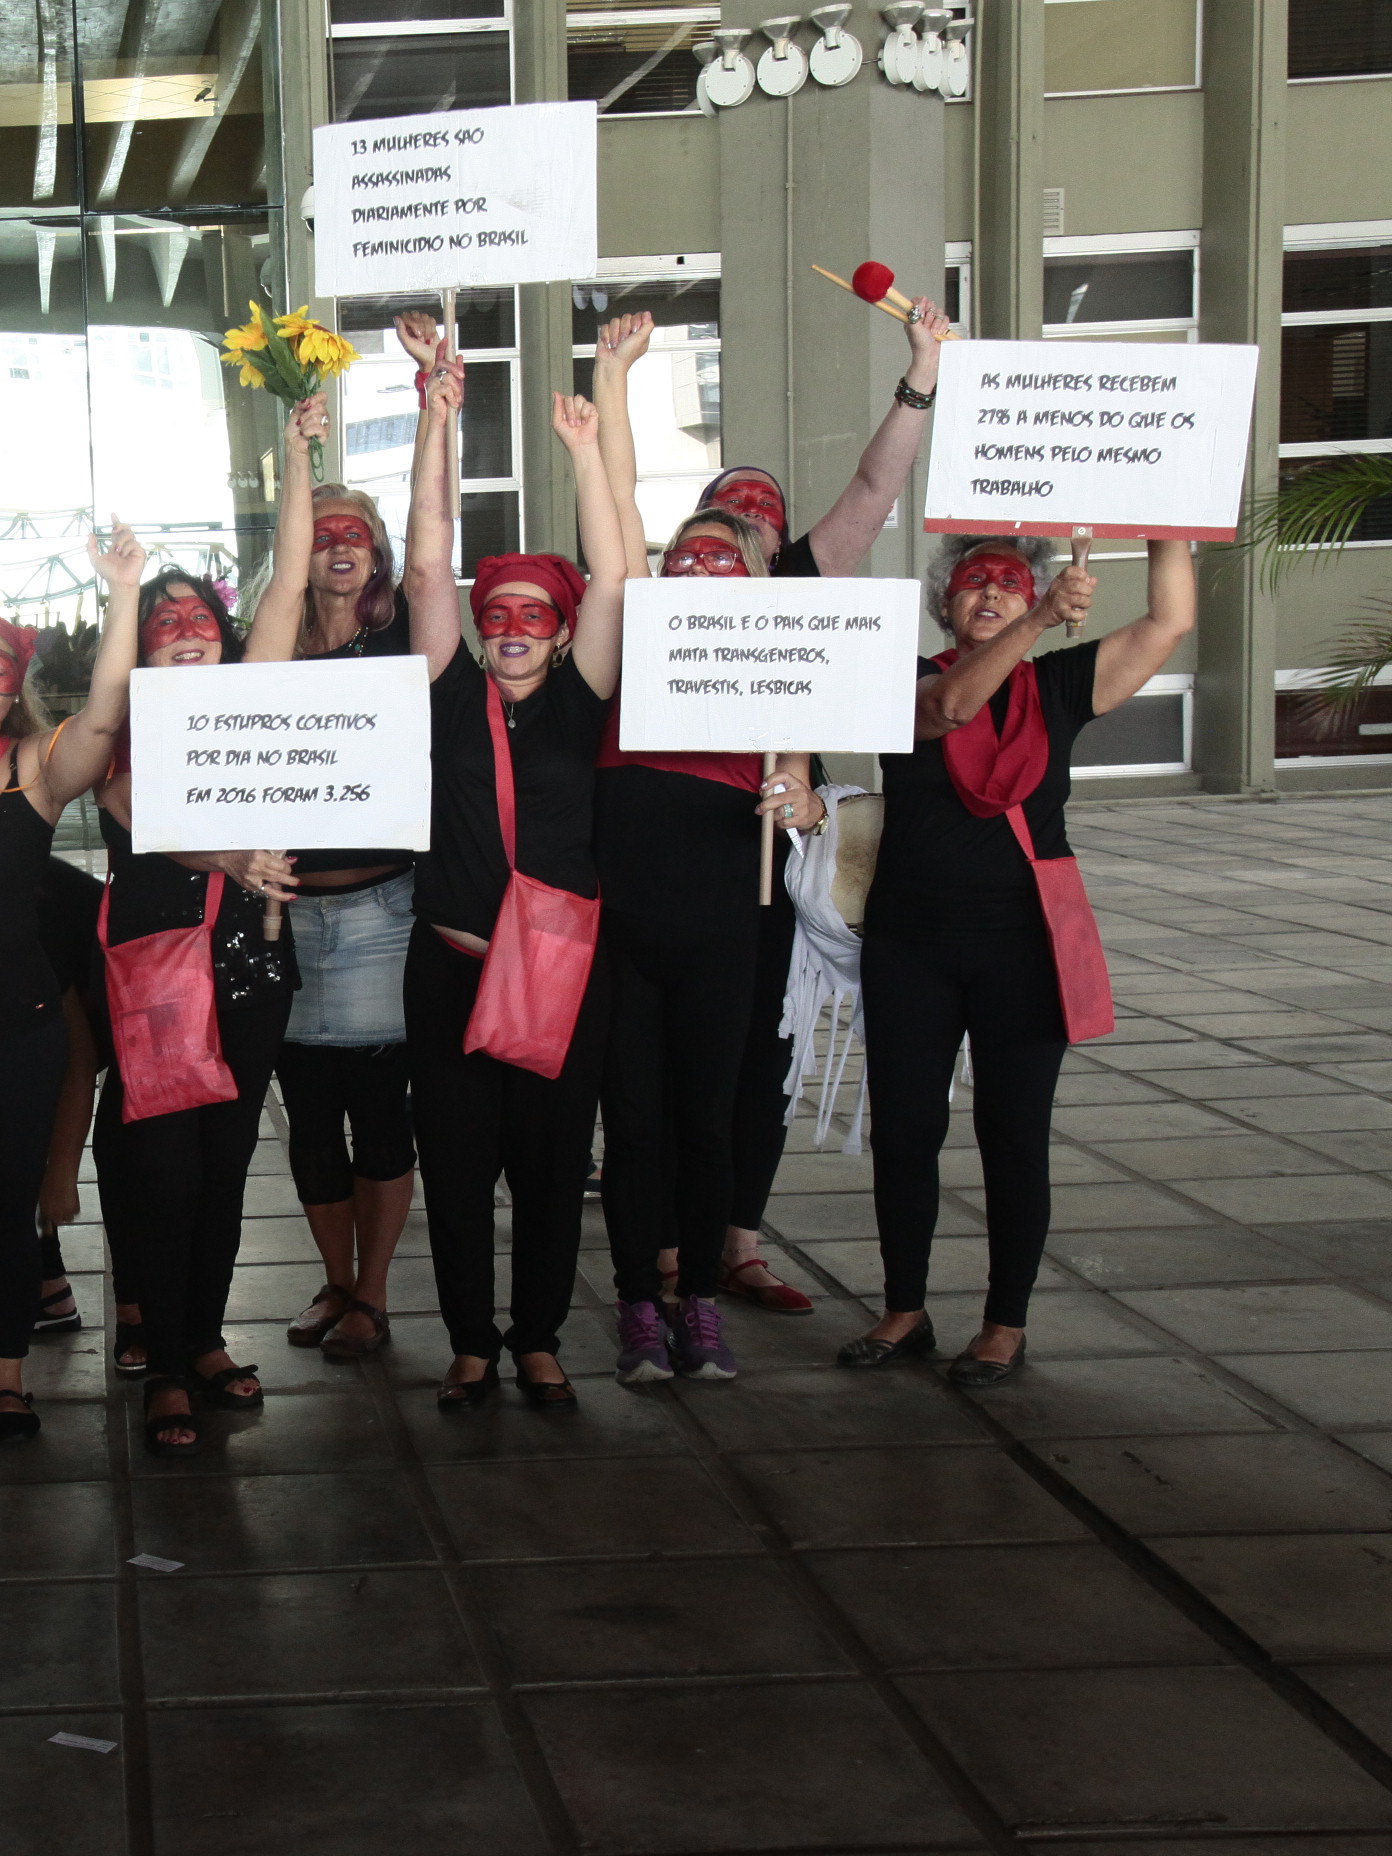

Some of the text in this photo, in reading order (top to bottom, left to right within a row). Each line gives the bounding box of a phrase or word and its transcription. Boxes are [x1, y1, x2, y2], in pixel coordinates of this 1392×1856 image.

[351, 127, 484, 155] 13 MULHERES SAO
[351, 165, 451, 190] ASSASSINADAS
[352, 197, 487, 223] DIARIAMENTE POR
[352, 230, 528, 257] FEMINICIDIO NO BRASIL
[981, 373, 1177, 392] AS MULHERES RECEBEM
[978, 409, 1195, 429] 27% A MENOS DO QUE OS
[974, 443, 1162, 465] HOMENS PELO MESMO
[971, 478, 1054, 498] TRABALHO
[668, 615, 881, 631] O BRASIL E O PAIS QUE MAIS
[669, 647, 708, 662] MATA
[750, 679, 812, 695] LESBICAS
[188, 714, 376, 731] 10 ESTUPROS COLETIVOS
[187, 749, 336, 767] POR DIA NO BRASIL
[186, 783, 371, 804] EM 2016 FORAM 3.256
